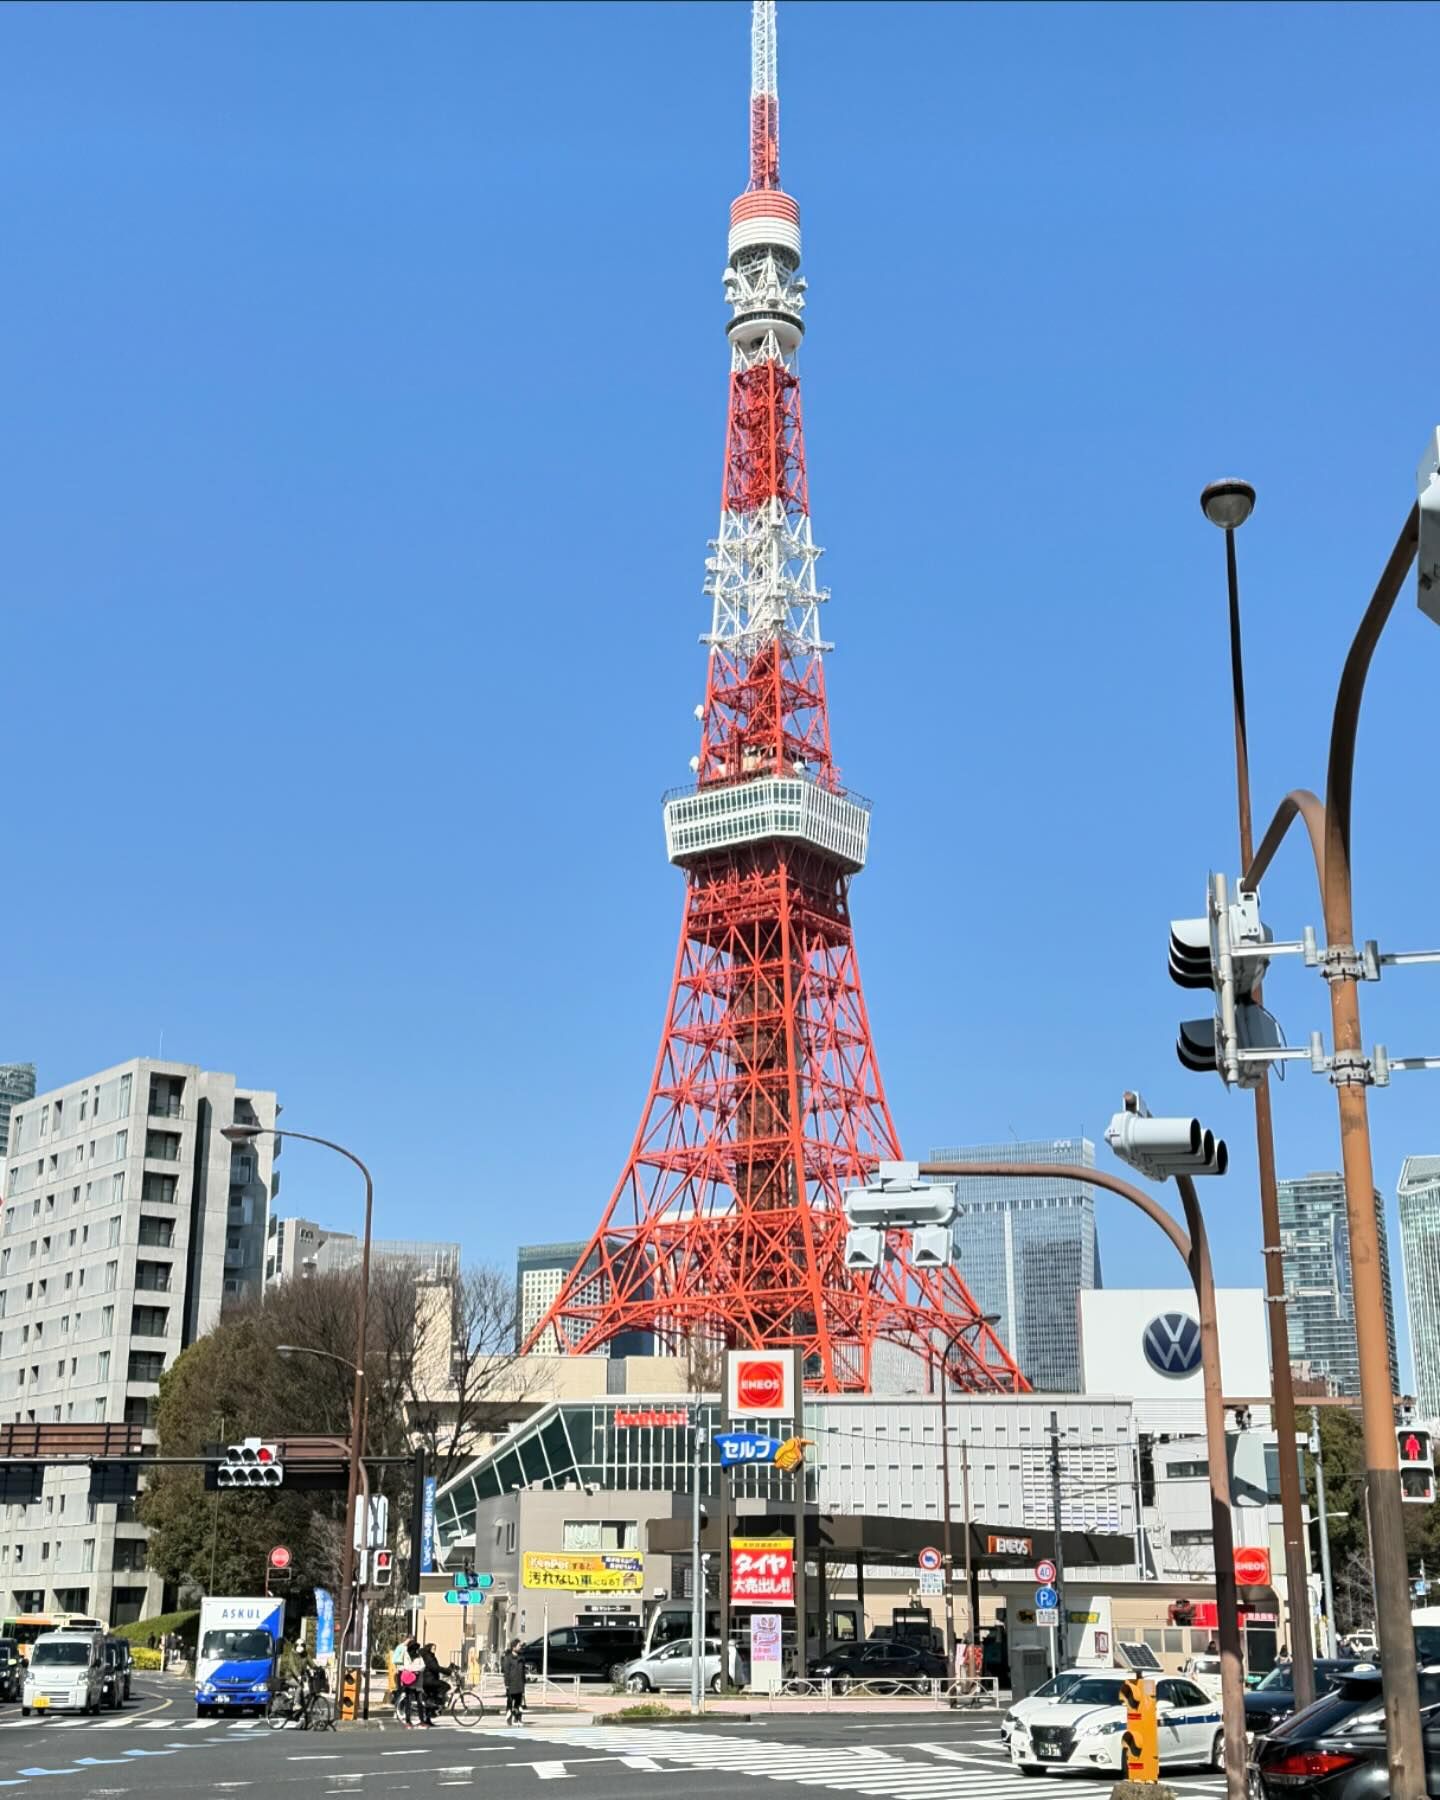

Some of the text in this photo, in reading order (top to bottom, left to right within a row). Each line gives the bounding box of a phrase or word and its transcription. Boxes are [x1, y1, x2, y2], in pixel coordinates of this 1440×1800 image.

[1146, 1313, 1202, 1370] VW
[741, 1379, 780, 1391] ENEOS
[722, 1440, 771, 1459] セルフ
[996, 1537, 1029, 1555] ENEOS
[735, 1552, 788, 1576] タイヤ
[1235, 1561, 1265, 1571] ENEOS
[1040, 1567, 1051, 1578] 40
[222, 1609, 260, 1619] ASKUL
